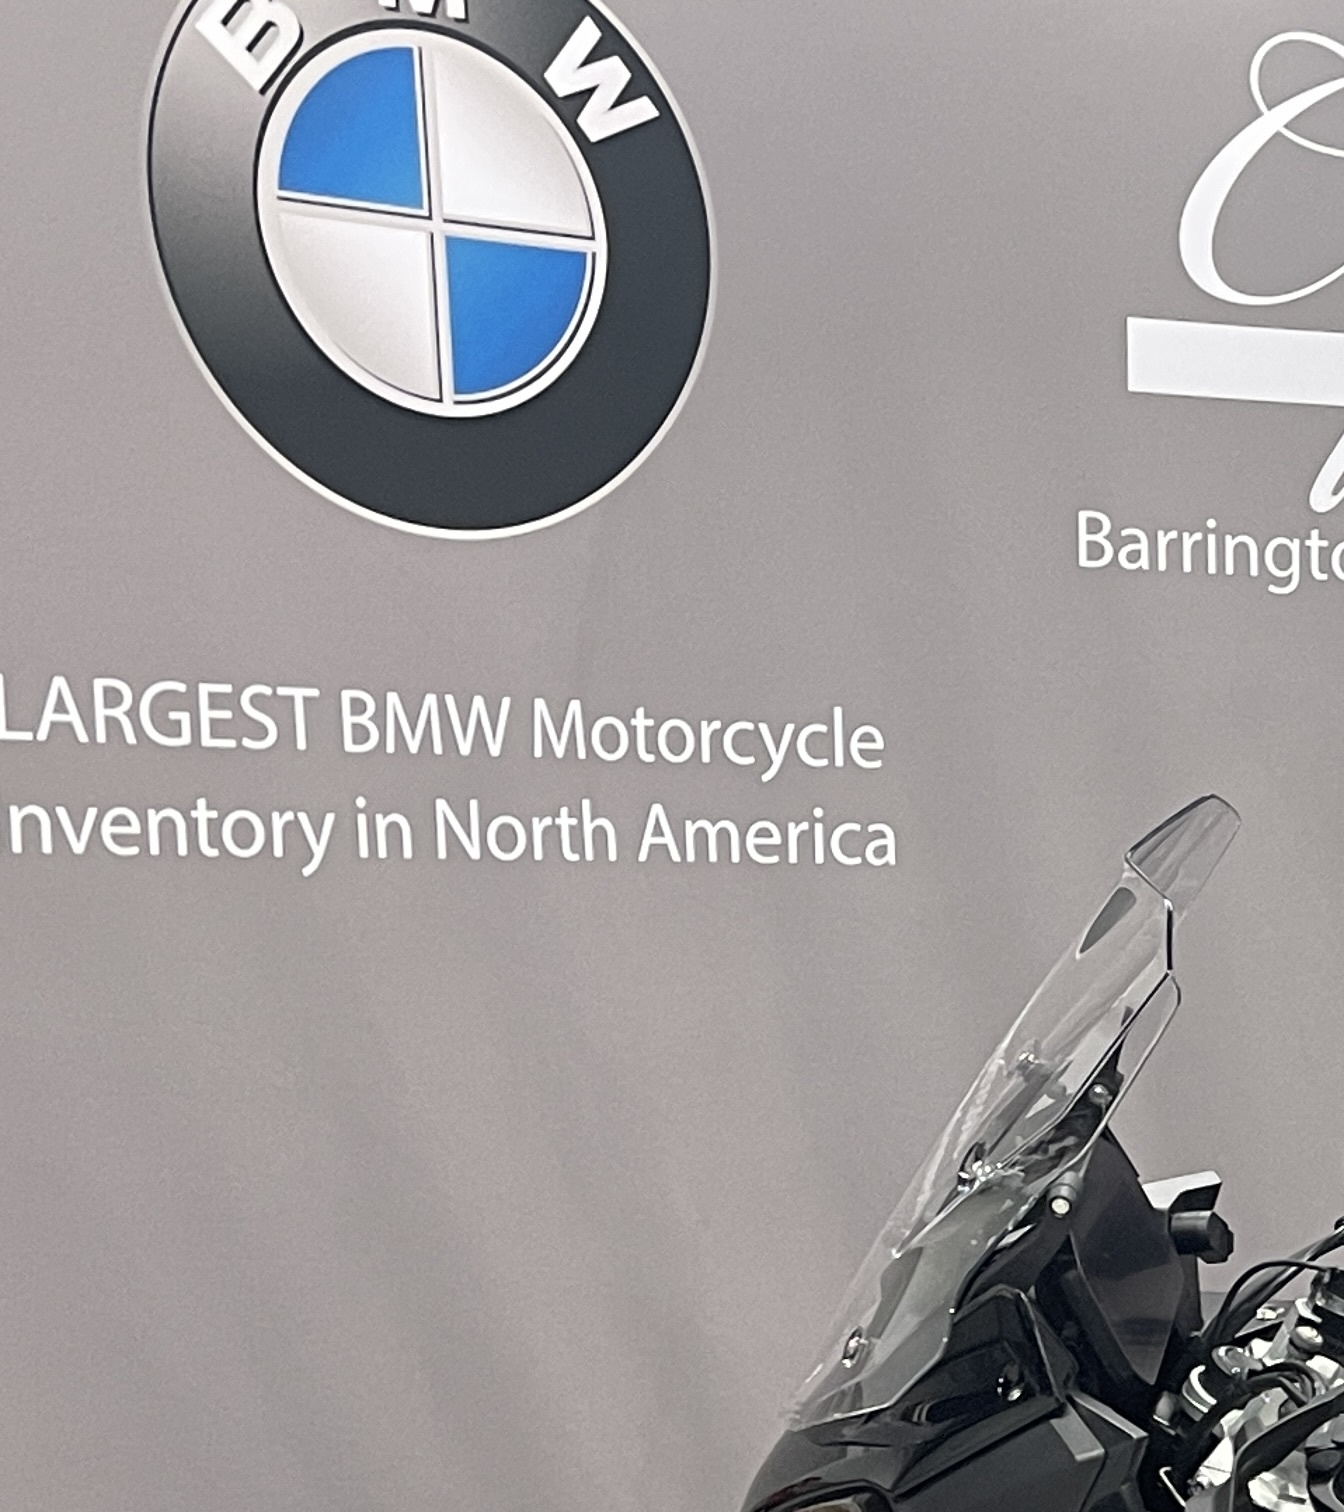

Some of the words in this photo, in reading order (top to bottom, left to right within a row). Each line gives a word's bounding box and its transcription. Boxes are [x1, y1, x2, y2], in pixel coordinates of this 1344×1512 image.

[195, 0, 661, 143] BW
[0, 673, 321, 751] LARGEST
[340, 689, 512, 758] BMW
[532, 697, 886, 783] Motorcycle
[8, 797, 336, 877] nventory
[355, 796, 414, 861] in
[434, 798, 618, 863] North
[637, 802, 897, 868] America
